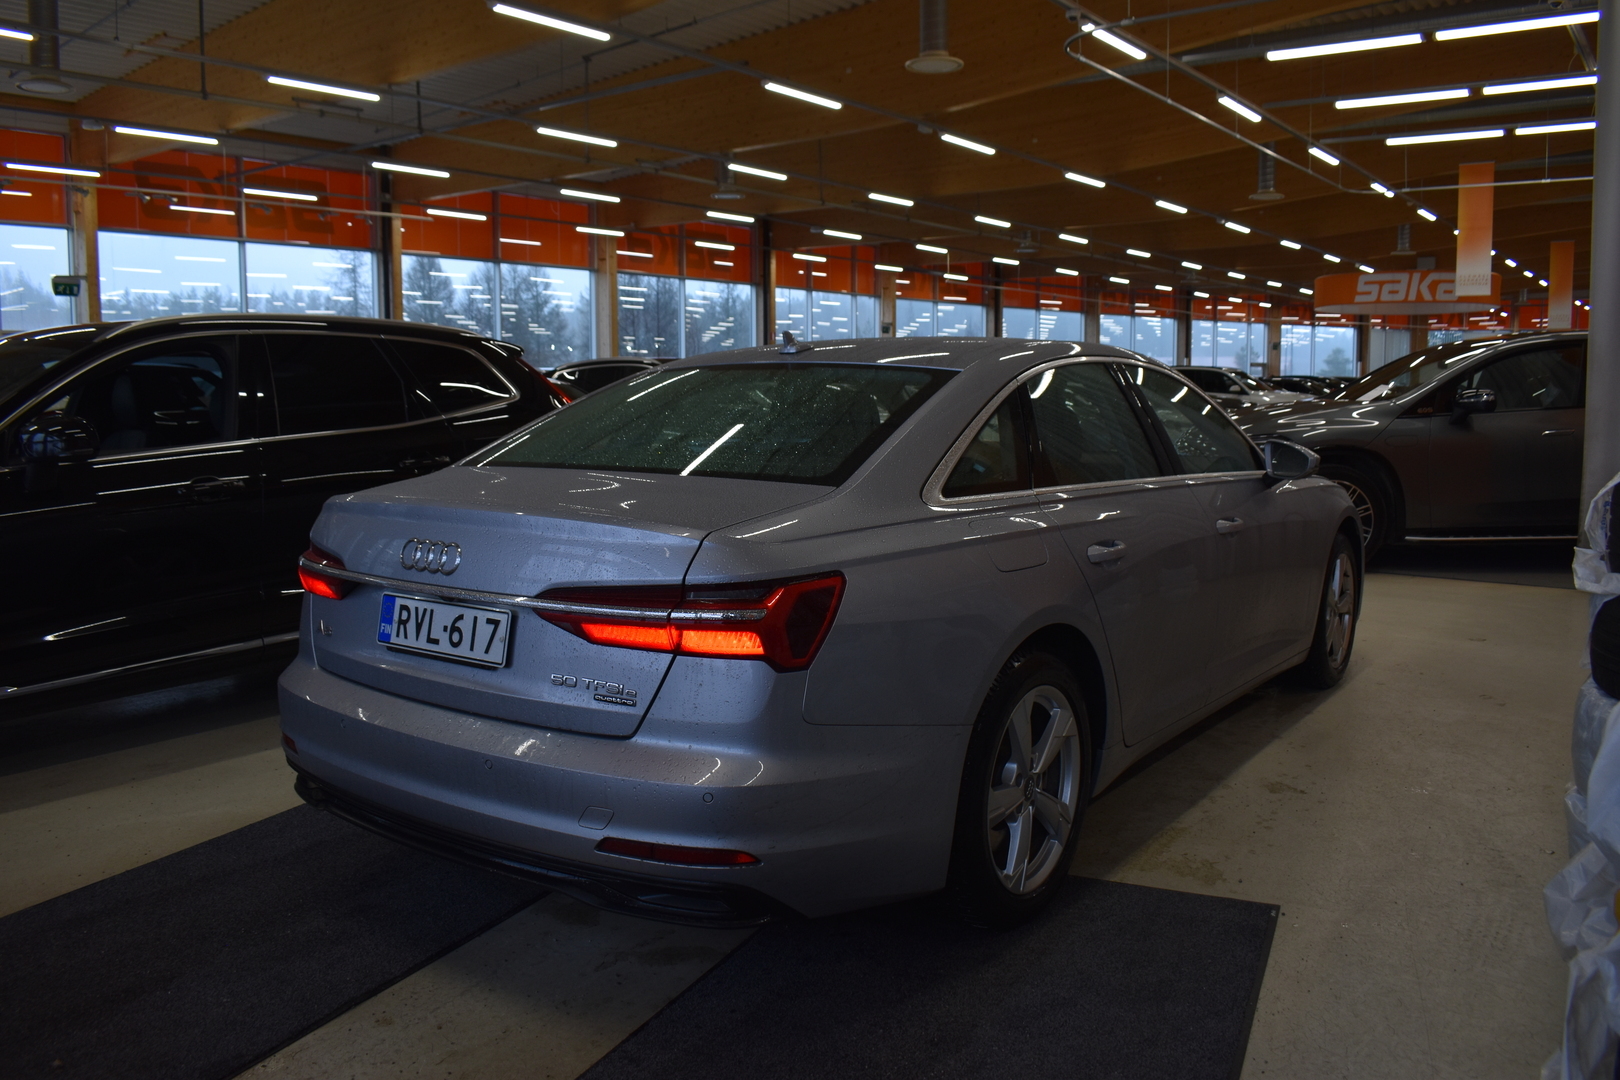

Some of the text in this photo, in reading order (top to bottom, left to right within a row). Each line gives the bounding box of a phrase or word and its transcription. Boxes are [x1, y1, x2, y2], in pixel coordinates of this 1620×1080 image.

[380, 622, 392, 634] FIN
[395, 604, 502, 654] RVL-617
[551, 673, 577, 688] 50
[594, 694, 634, 706] quattro
